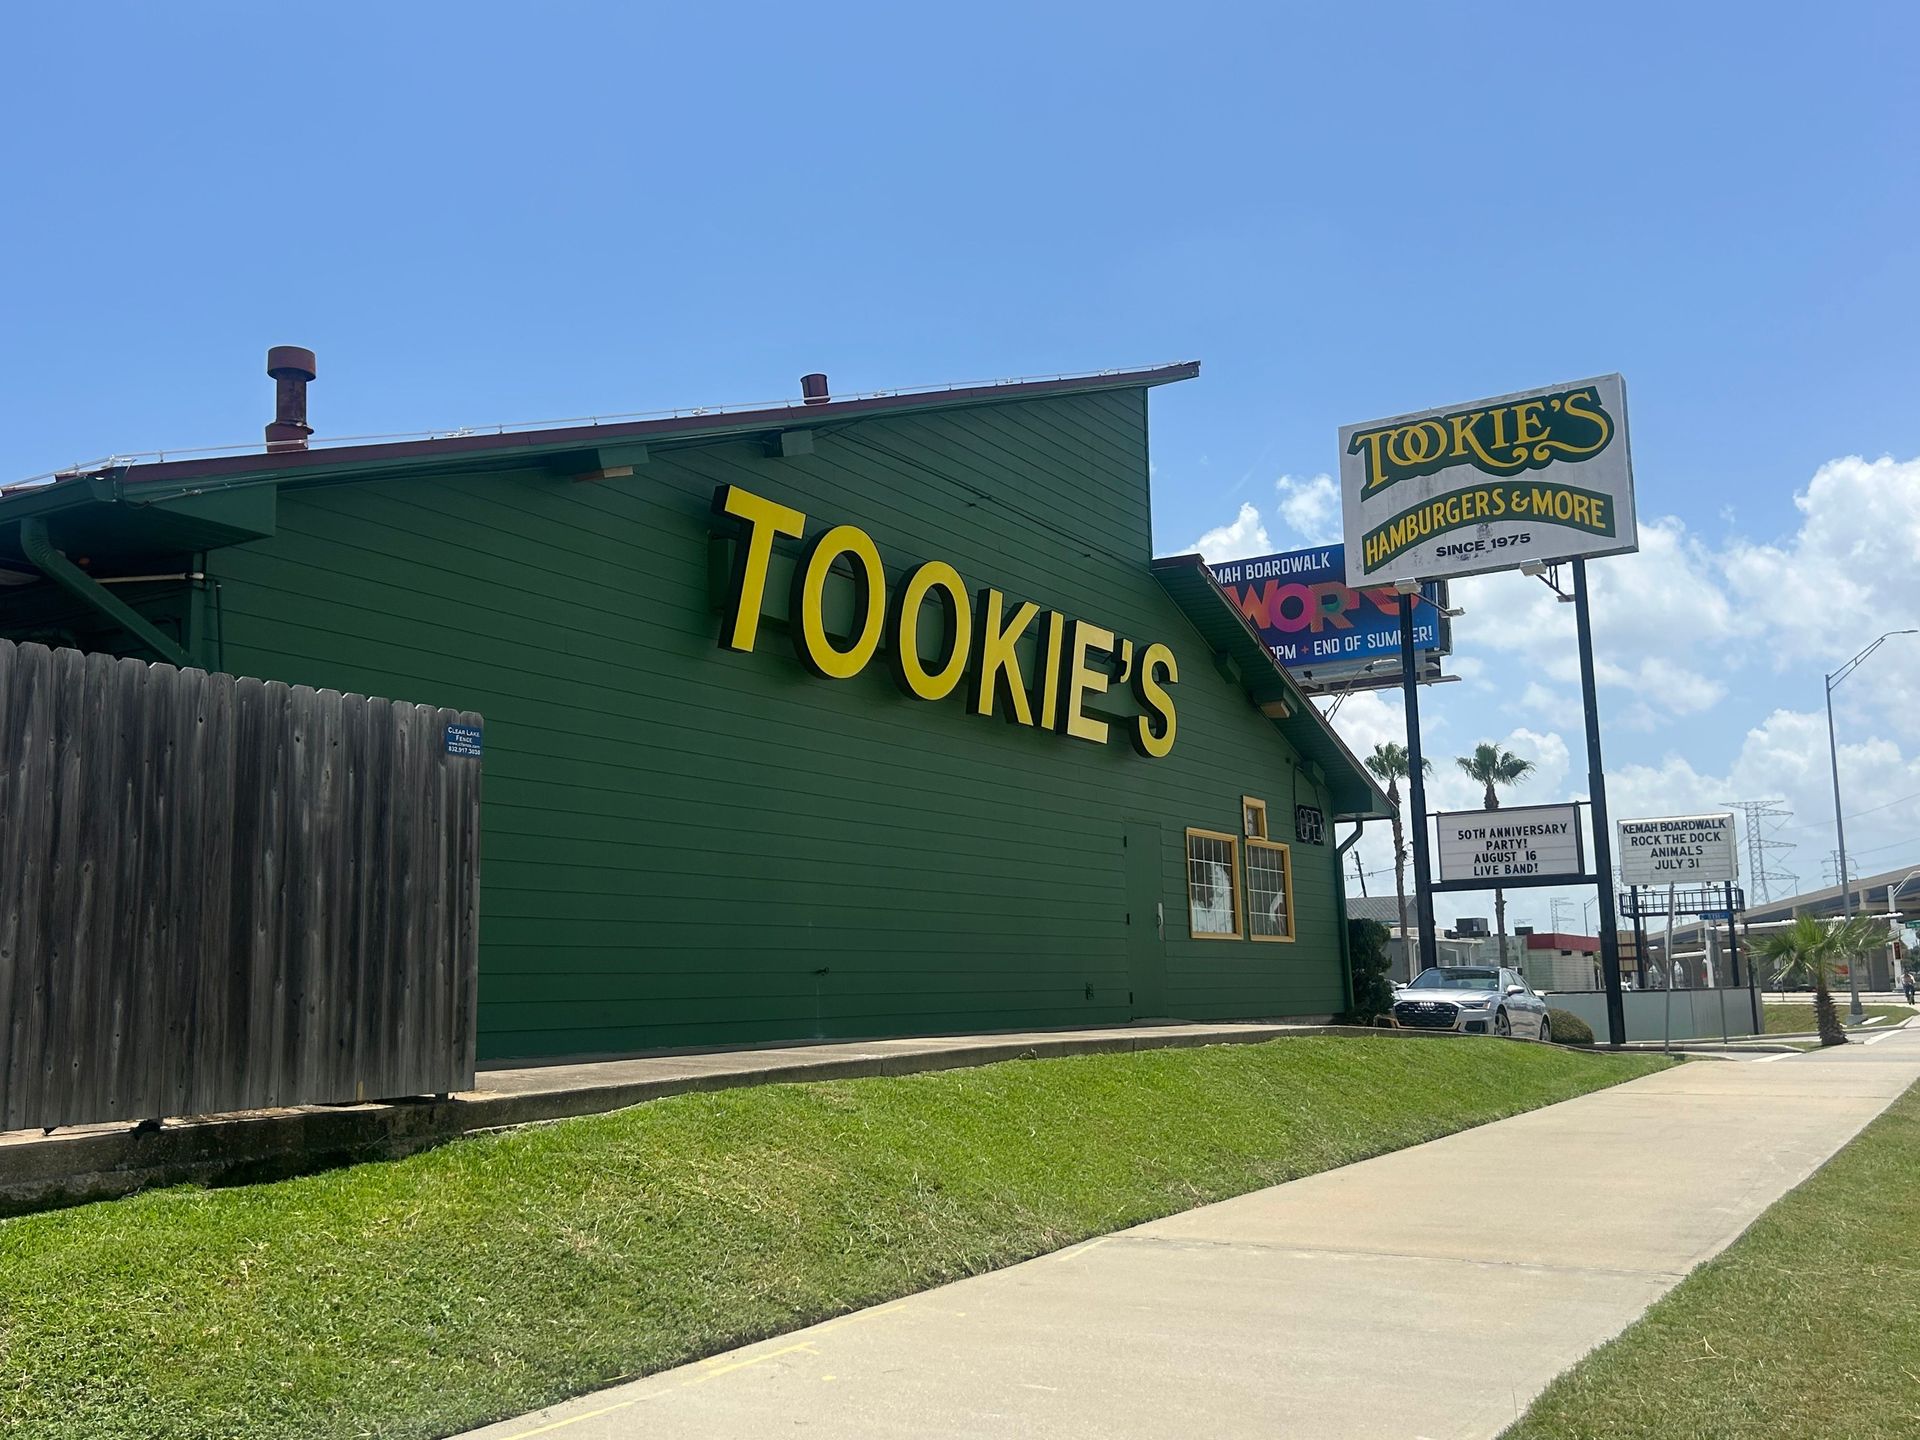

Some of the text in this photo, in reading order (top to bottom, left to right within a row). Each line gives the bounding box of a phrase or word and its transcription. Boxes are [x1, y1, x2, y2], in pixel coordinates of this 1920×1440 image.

[1356, 392, 1609, 489] TOOKIE'S
[1365, 488, 1606, 566] HAMBURGERS & MORE
[1436, 533, 1531, 557] SINCE 1975
[1211, 552, 1331, 584] MAH BOARDWALK
[713, 484, 1179, 758] TOOKIE'S
[1314, 638, 1340, 656] END
[1345, 635, 1361, 651] OF
[1367, 625, 1433, 649] SUMER!
[448, 727, 465, 735] CLEAR
[456, 735, 472, 743] FENCE
[1458, 823, 1567, 840] 50TH ANNIVERSARY
[1623, 818, 1726, 834] KEMAH BOARDWALK
[1486, 838, 1528, 850] PARTY!
[1631, 831, 1722, 846] ROCK THE DOCK
[1474, 850, 1537, 864] AUGUST 16
[1650, 845, 1703, 858] ANIMALS
[1474, 863, 1538, 876] LIVE BAND!
[1655, 858, 1700, 870] JULY 31
